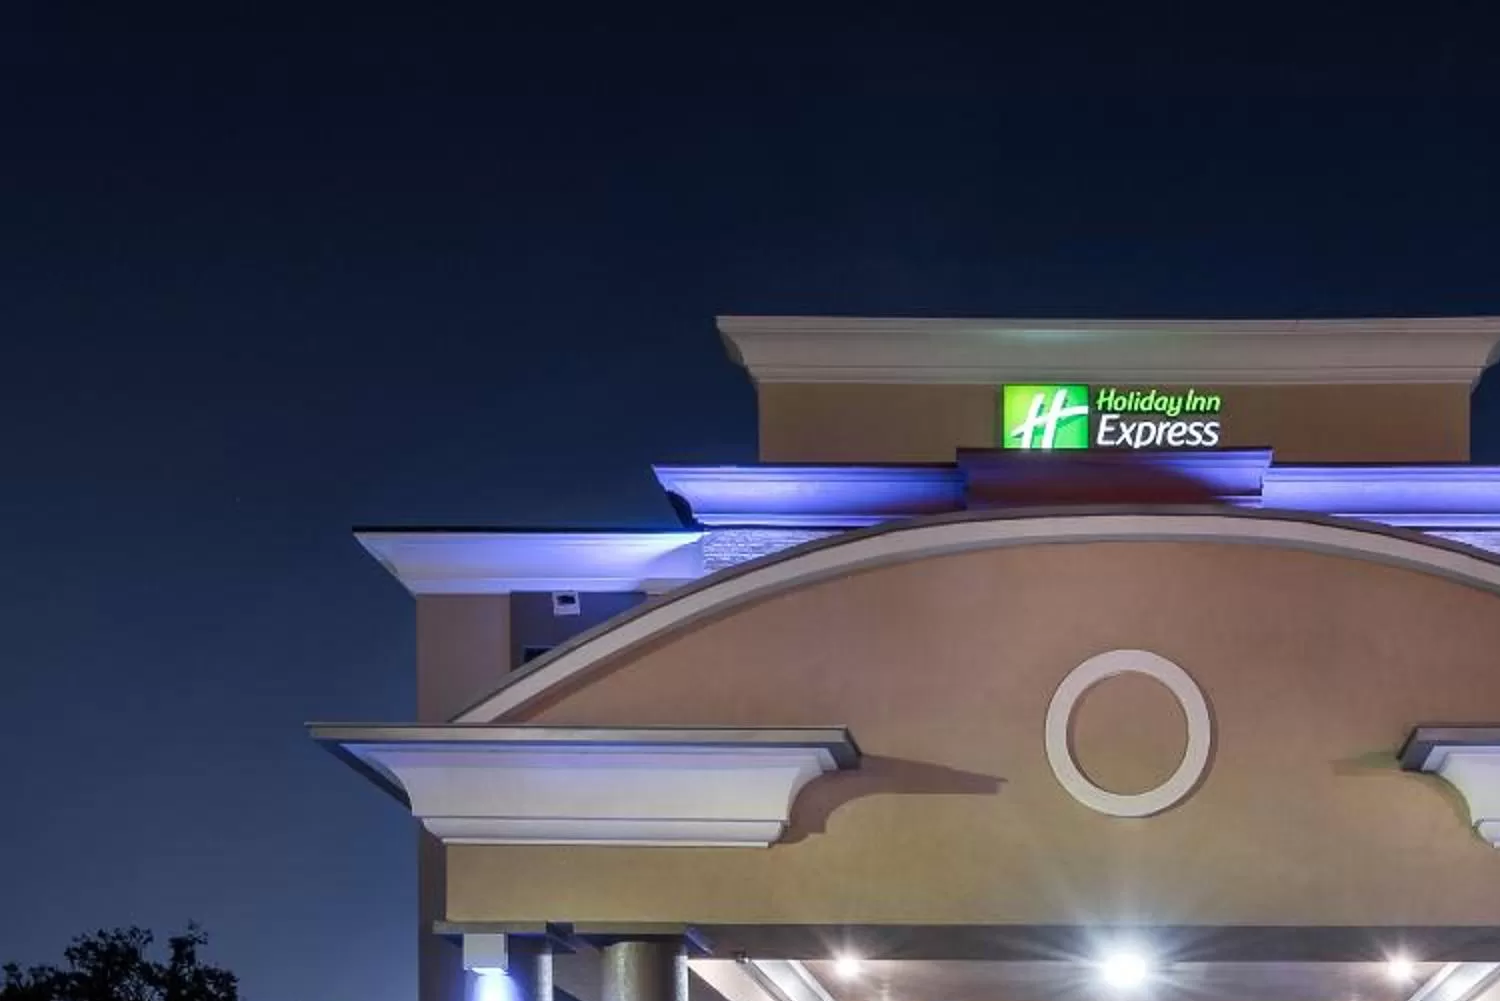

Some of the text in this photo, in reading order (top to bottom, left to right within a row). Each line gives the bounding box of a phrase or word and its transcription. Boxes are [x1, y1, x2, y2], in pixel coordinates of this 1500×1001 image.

[1096, 388, 1221, 417] Holiday Inn
[1097, 414, 1220, 449] Express
